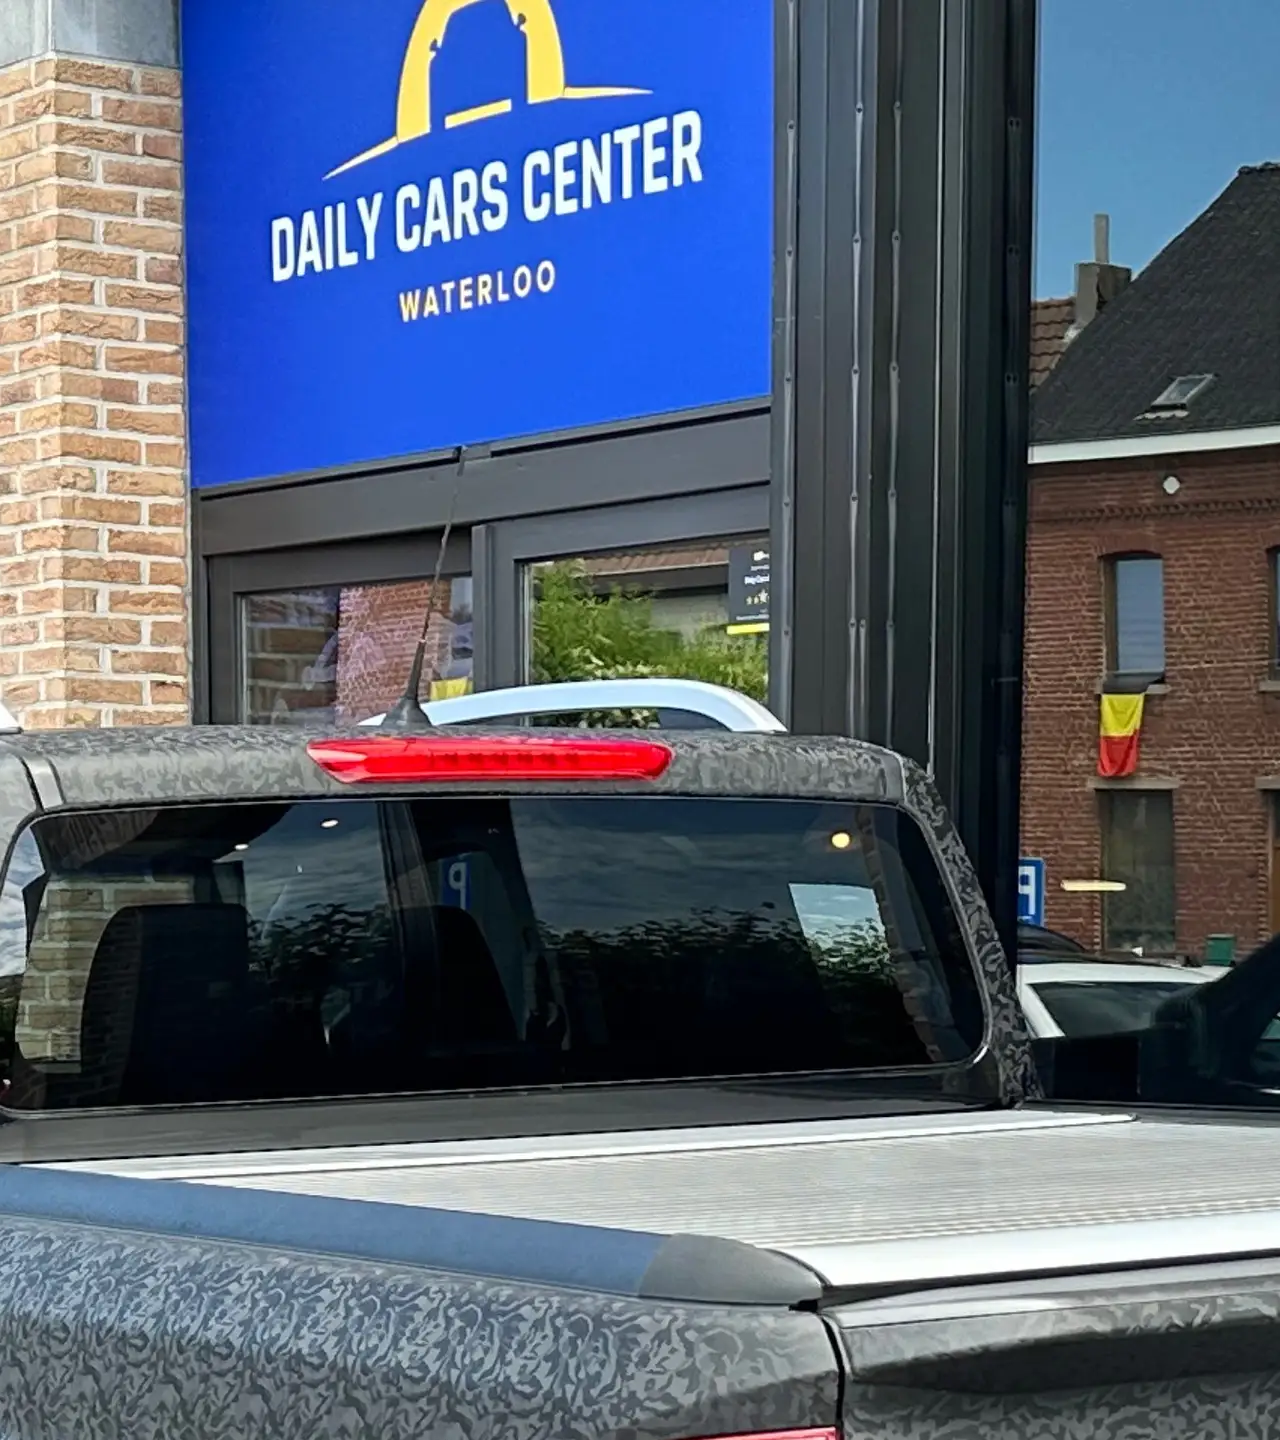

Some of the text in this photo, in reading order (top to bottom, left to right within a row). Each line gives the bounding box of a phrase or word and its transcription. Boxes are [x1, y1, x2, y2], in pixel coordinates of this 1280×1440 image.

[271, 110, 703, 282] DAILY CARS CENTER
[399, 260, 556, 323] WATERLOO
